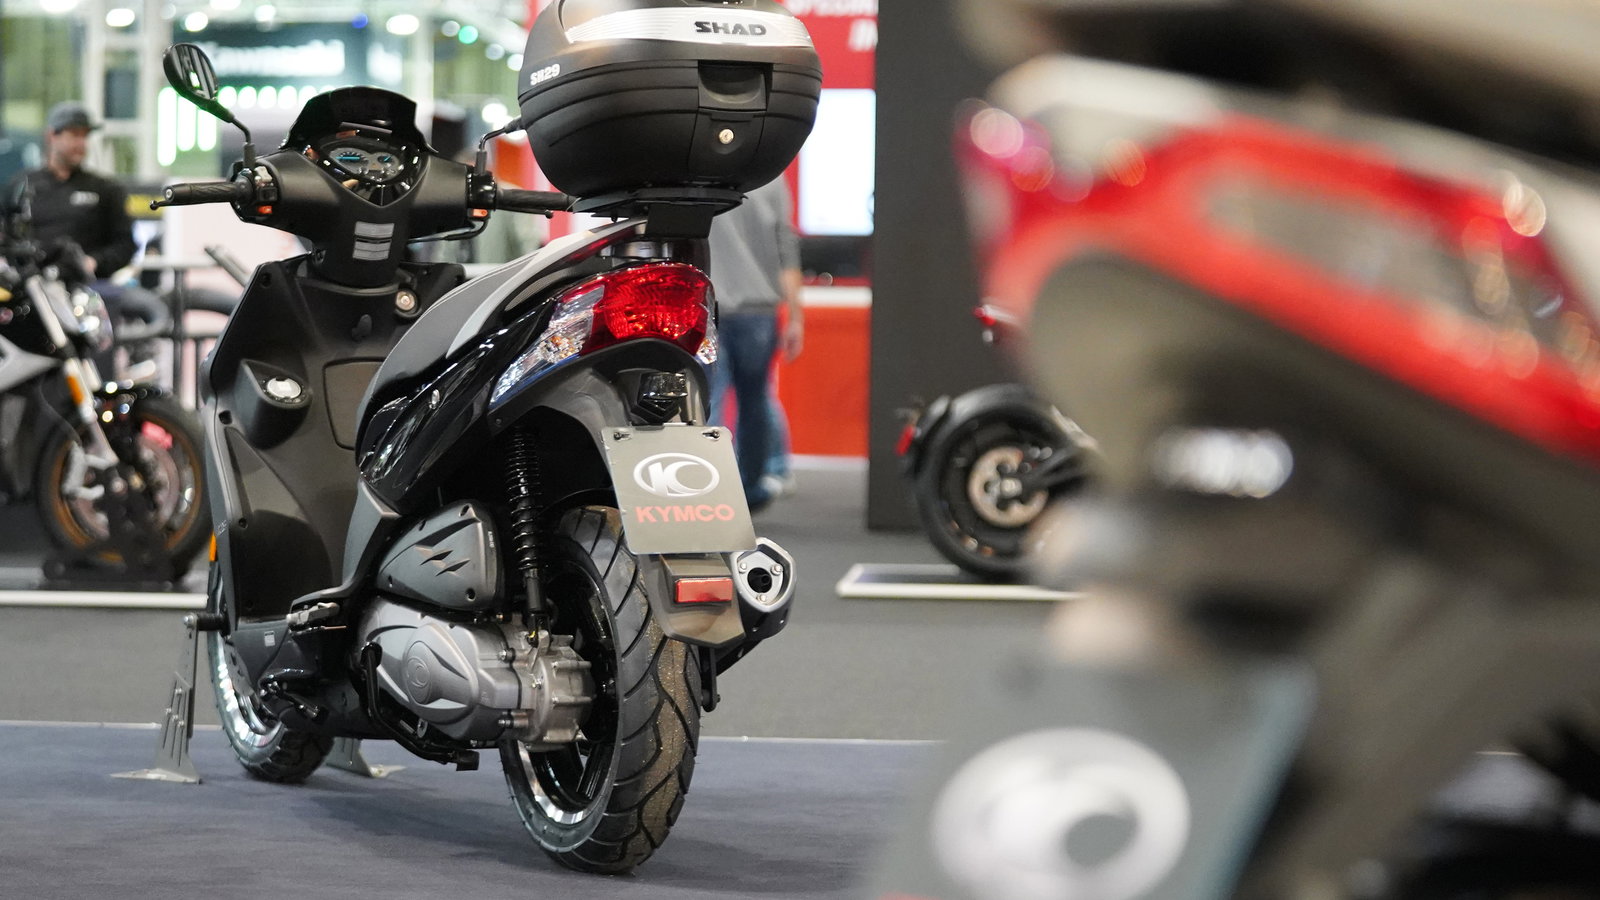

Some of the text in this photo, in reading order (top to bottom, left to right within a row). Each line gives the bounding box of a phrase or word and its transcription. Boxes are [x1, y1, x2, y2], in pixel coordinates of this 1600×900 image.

[694, 21, 767, 36] SHAD
[529, 63, 561, 86] SH29
[634, 503, 735, 523] KYMCO
